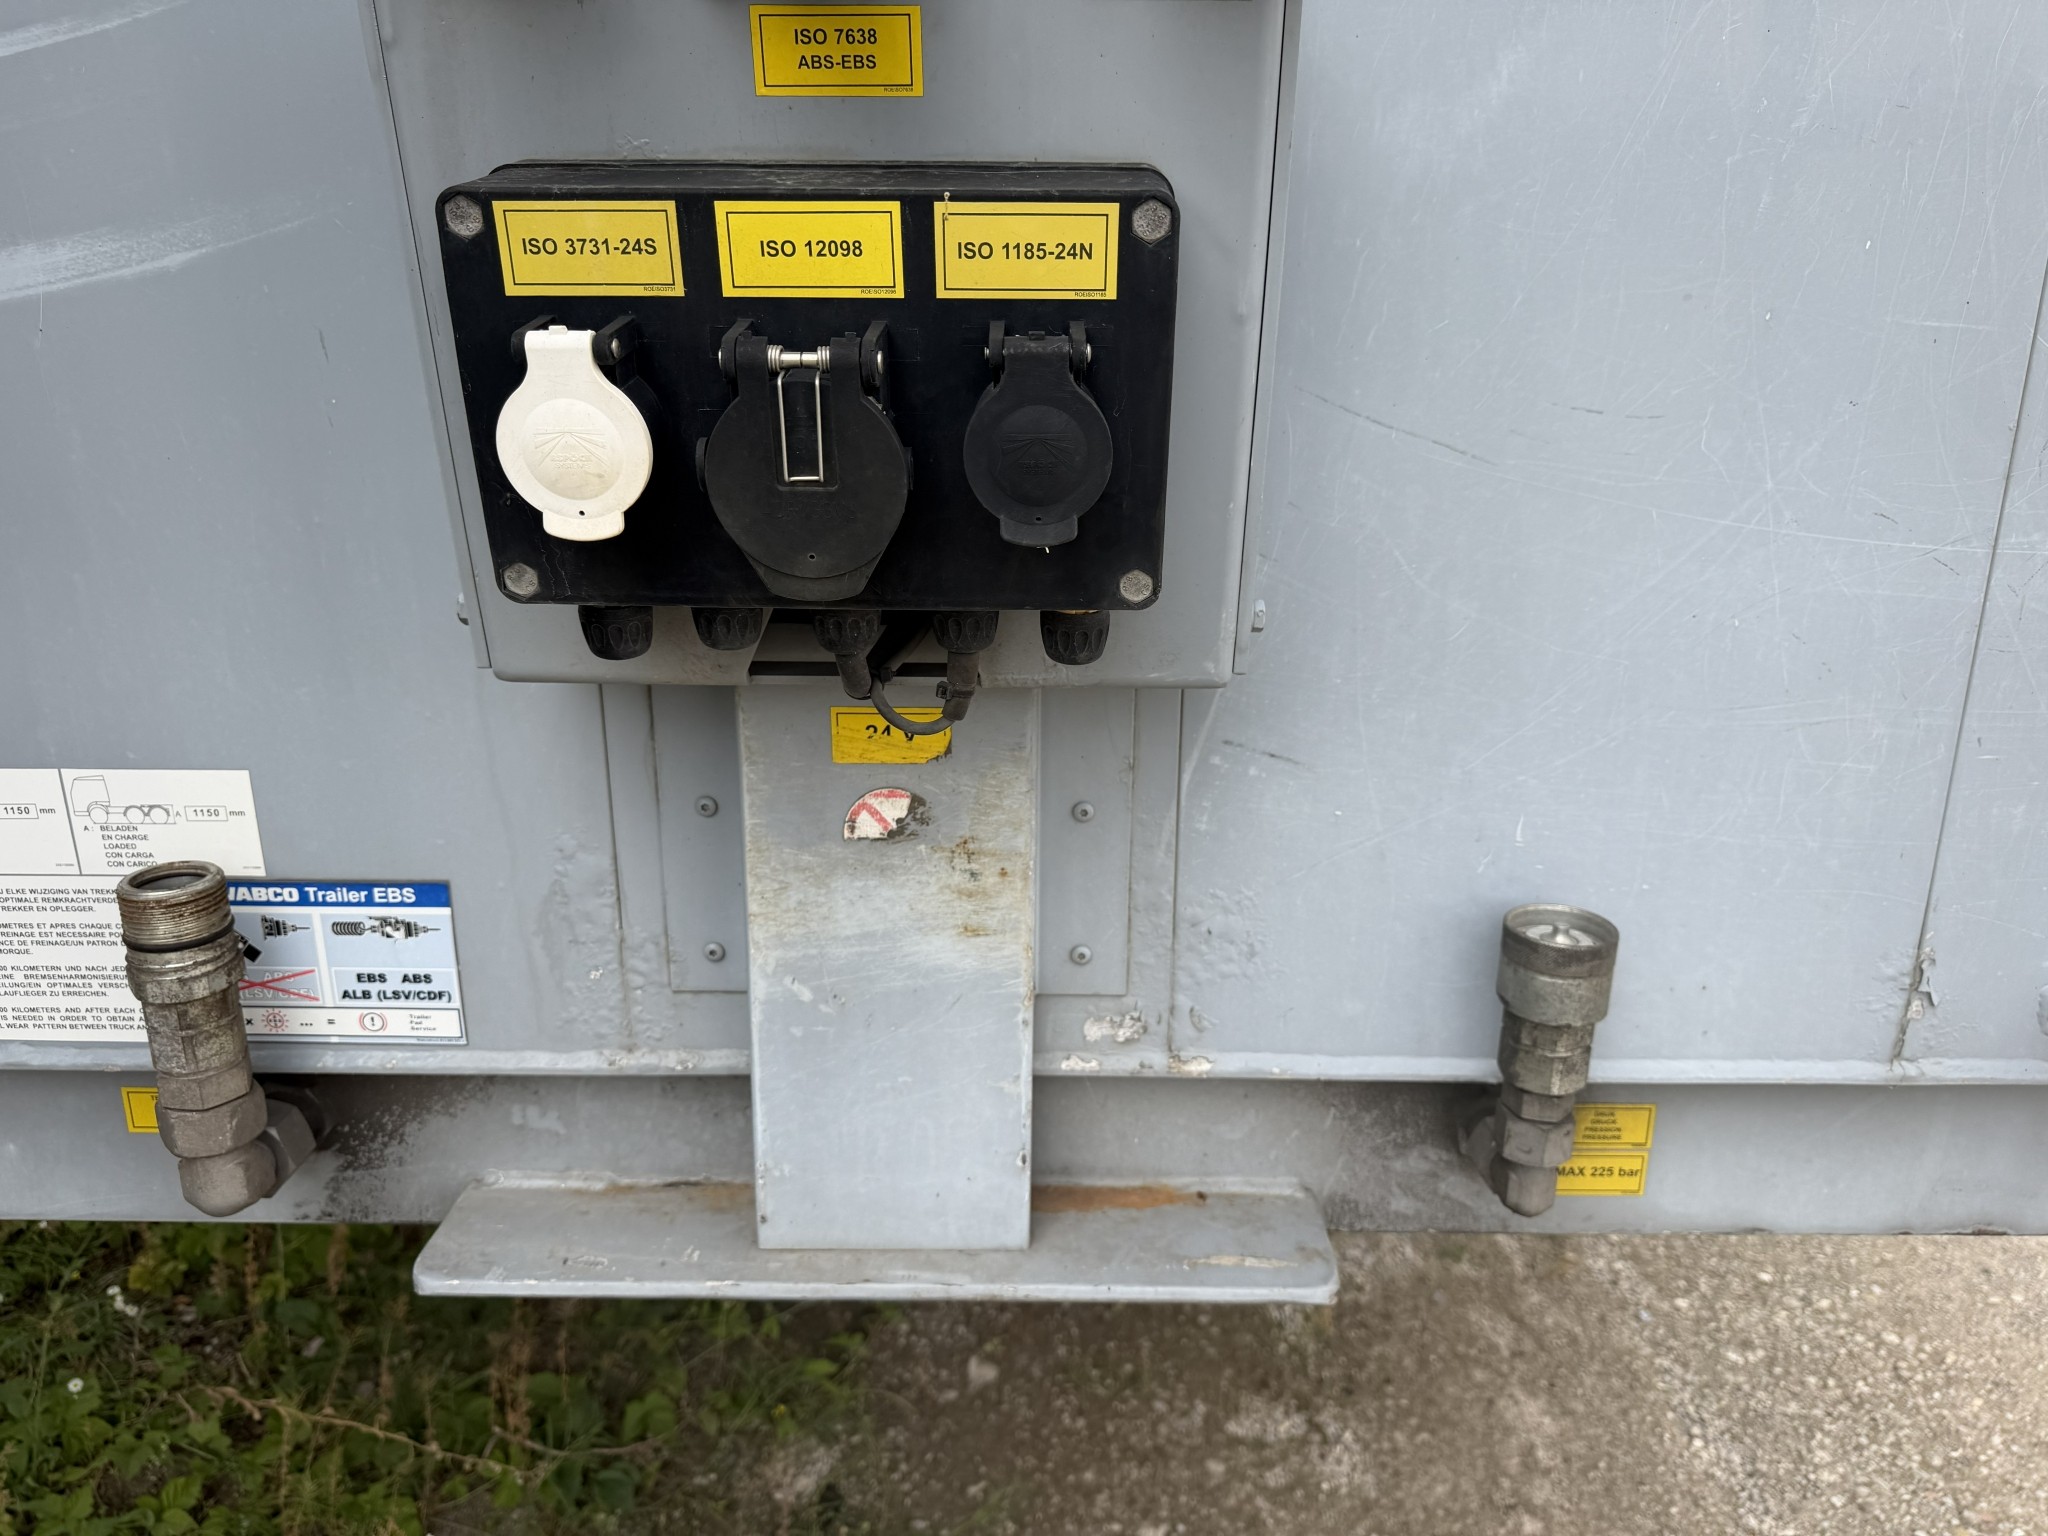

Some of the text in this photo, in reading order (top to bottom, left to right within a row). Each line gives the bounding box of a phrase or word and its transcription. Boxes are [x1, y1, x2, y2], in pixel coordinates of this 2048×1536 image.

[794, 28, 878, 45] ISO 7638
[798, 55, 877, 70] ABS-EBS
[522, 238, 658, 255] ISO 3731-24S
[760, 240, 863, 257] ISO 12098
[957, 242, 1093, 260] ISO 1185-24N
[3, 806, 56, 816] 1150 mm
[175, 810, 182, 818] A
[192, 808, 220, 818] 1150
[107, 860, 125, 868] CON
[304, 887, 368, 902] Trailer
[372, 888, 416, 903] EBS
[79, 923, 112, 931] CHAQUE
[356, 973, 433, 984] EBS ABS
[342, 989, 452, 1003] ALB (LSV/CDF)
[106, 1015, 135, 1023] OBTAIN
[69, 1023, 107, 1031] BETWEEN
[108, 1023, 135, 1031] TRUCK
[1556, 1166, 1640, 1177] MAX 225 bar
